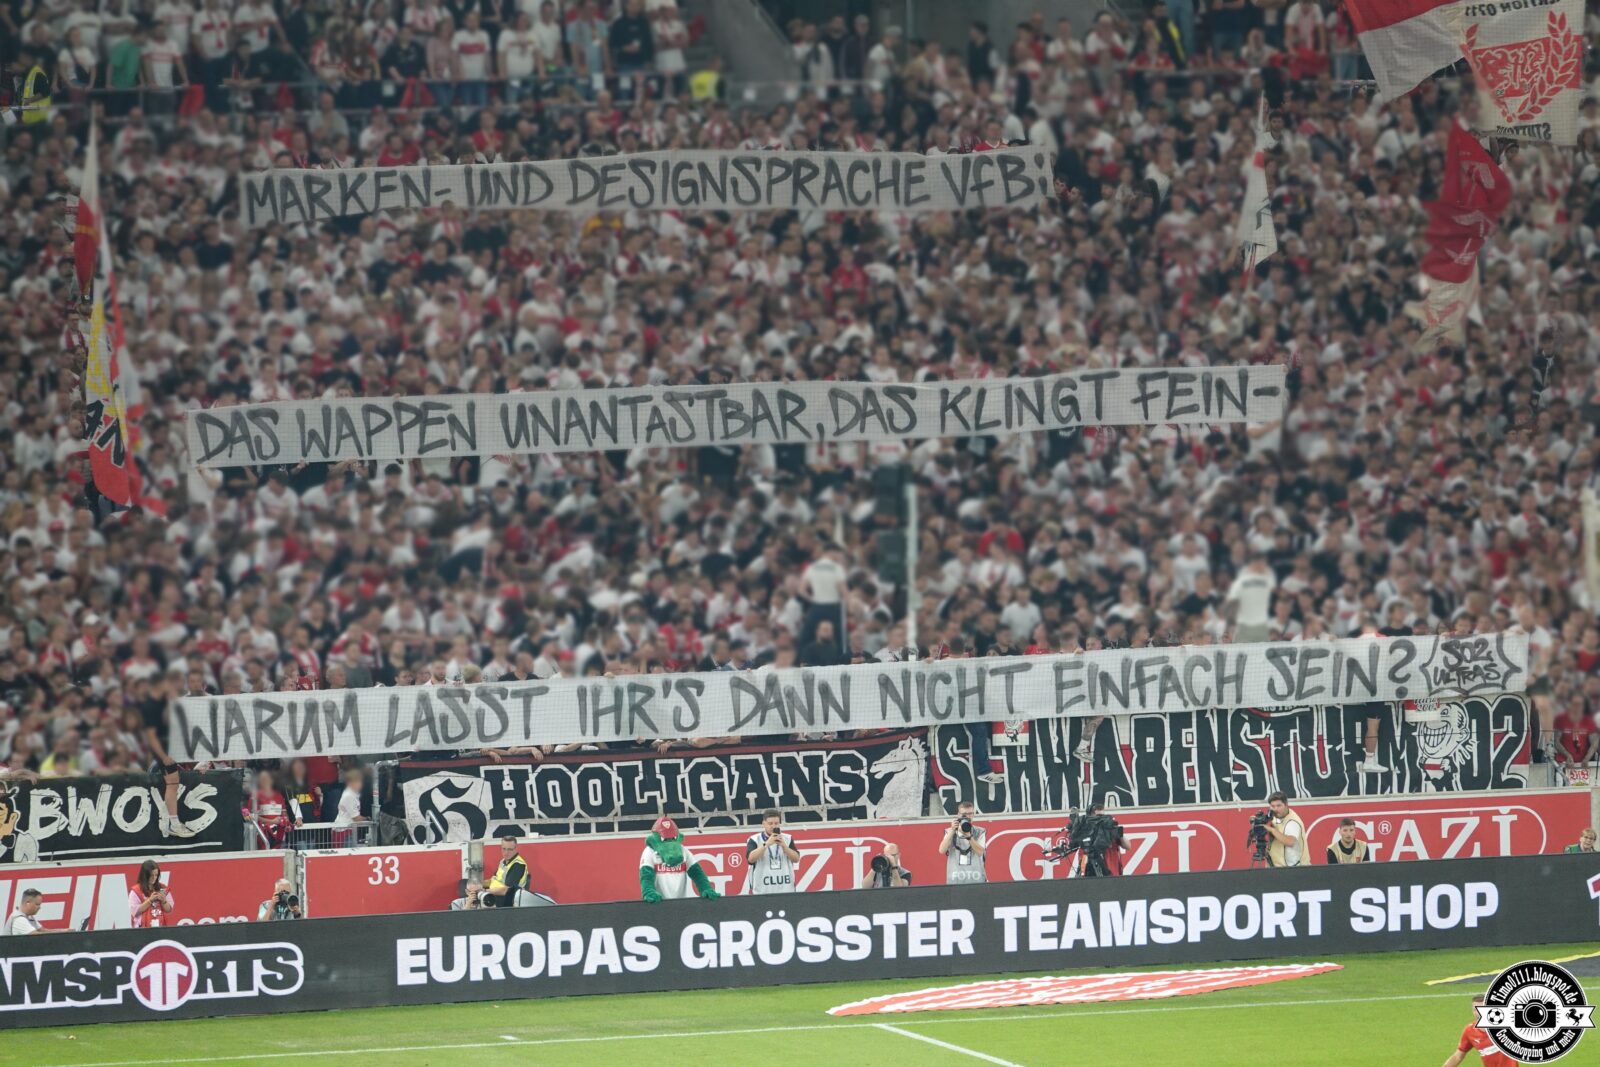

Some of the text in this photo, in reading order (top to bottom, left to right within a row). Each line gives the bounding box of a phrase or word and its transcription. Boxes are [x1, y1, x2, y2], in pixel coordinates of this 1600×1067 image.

[245, 169, 451, 224] MARKEN-
[464, 164, 554, 206] UND
[567, 156, 930, 209] DESIGNSPRACHE
[196, 407, 281, 463] DAS
[295, 400, 477, 458] WAPPEN
[940, 370, 1120, 433] KLINGT
[1131, 368, 1281, 421] FEIN-
[175, 690, 361, 760] WARUM
[385, 685, 550, 749] LASST
[576, 677, 705, 737] IHR'S
[727, 671, 851, 733] DANN
[878, 662, 1033, 723] NICHT
[1053, 651, 1247, 714] EINFACH
[480, 750, 868, 821] HOOLIGANS
[367, 855, 401, 885] 33
[763, 875, 791, 886] CLUB
[951, 870, 981, 881] FOTO
[396, 881, 1499, 986] EUROPAS GRÖSSTER TEAMSPORT SHOP
